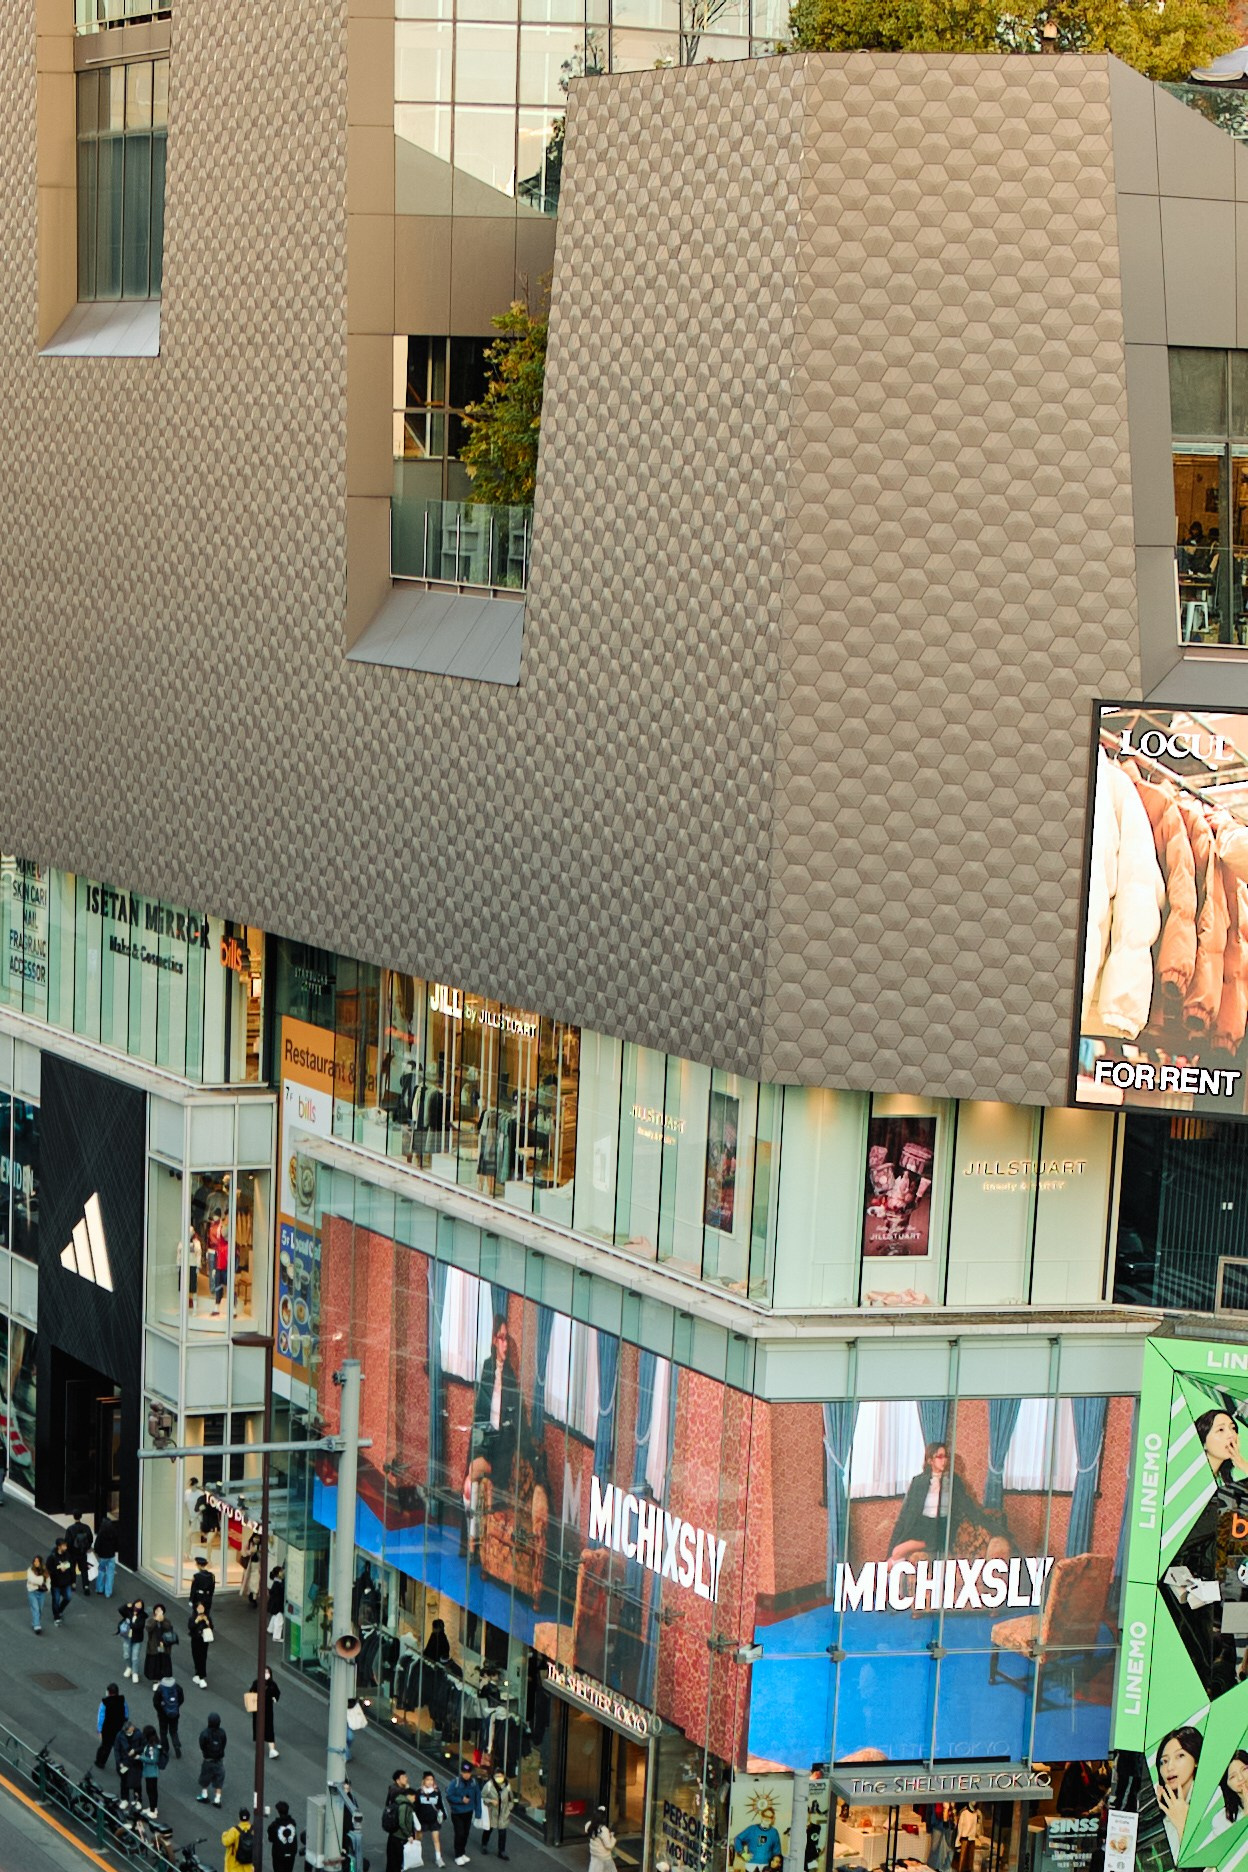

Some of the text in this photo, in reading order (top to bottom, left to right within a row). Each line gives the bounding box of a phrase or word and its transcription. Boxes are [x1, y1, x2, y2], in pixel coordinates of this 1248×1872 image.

[86, 884, 139, 927] ISETAN
[109, 935, 183, 975] Make & Cosmetics
[219, 934, 242, 972] bills
[430, 983, 536, 1039] JILL by JILLSTUART
[285, 1039, 345, 1082] Restaurant
[1094, 1060, 1241, 1097] FOR RENT
[299, 1095, 316, 1124] bills
[629, 1104, 686, 1134] JILLSTUART
[964, 1161, 1087, 1176] JILLSTUART
[1139, 1433, 1163, 1529] LINEMO
[205, 1490, 232, 1517] TOKYU
[589, 1475, 726, 1604] MICHIXSLY
[834, 1556, 1054, 1612] MICHIXSLY
[1124, 1621, 1148, 1715] LINEMO
[546, 1661, 566, 1687] The
[612, 1700, 648, 1736] TOKYO
[852, 1779, 887, 1794] The
[988, 1771, 1051, 1789] TOKYO
[1050, 1817, 1099, 1833] SINSS
